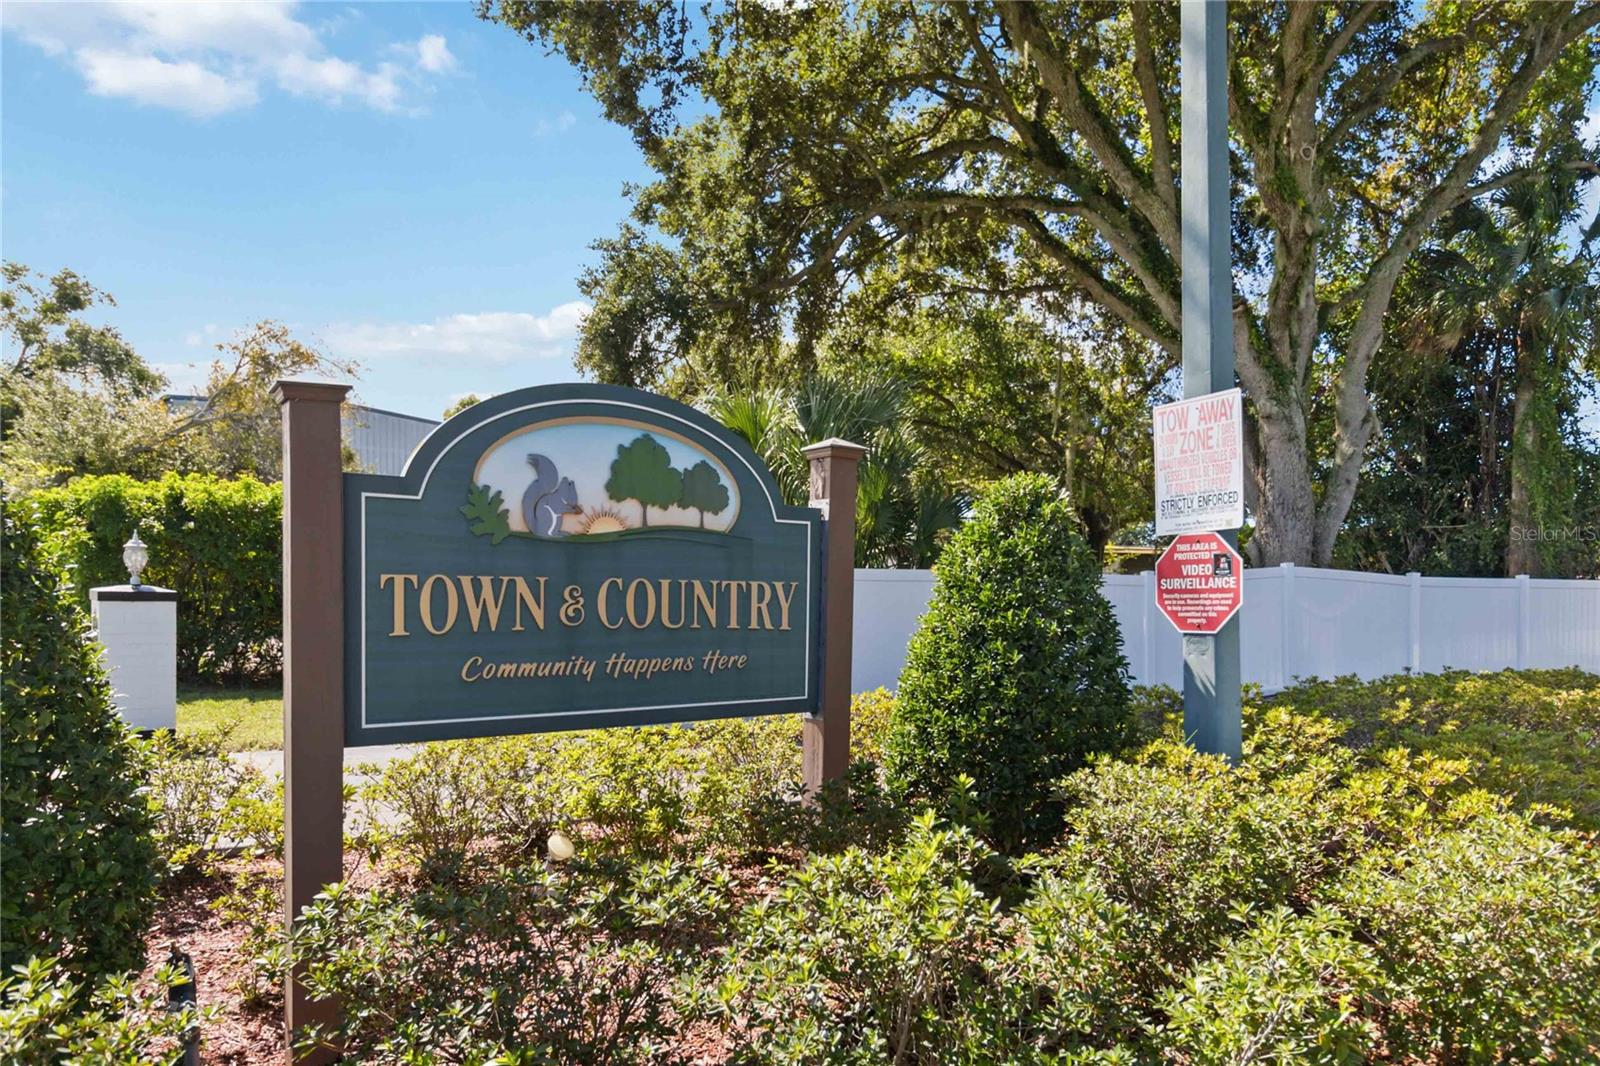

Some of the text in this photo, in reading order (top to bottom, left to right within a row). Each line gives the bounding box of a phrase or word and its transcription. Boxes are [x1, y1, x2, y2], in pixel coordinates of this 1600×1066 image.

[1158, 396, 1235, 432] TOW AWAY
[1180, 427, 1214, 454] ZONE
[1161, 497, 1194, 512] STRICTLY
[1198, 491, 1238, 507] ENFORCED
[1174, 552, 1210, 560] PROTECTED
[1182, 564, 1212, 576] VIDEO
[1160, 576, 1236, 590] SURVEILLANCE
[380, 574, 798, 636] TOWN & COUNTRY
[462, 649, 748, 682] Community Happens Here
